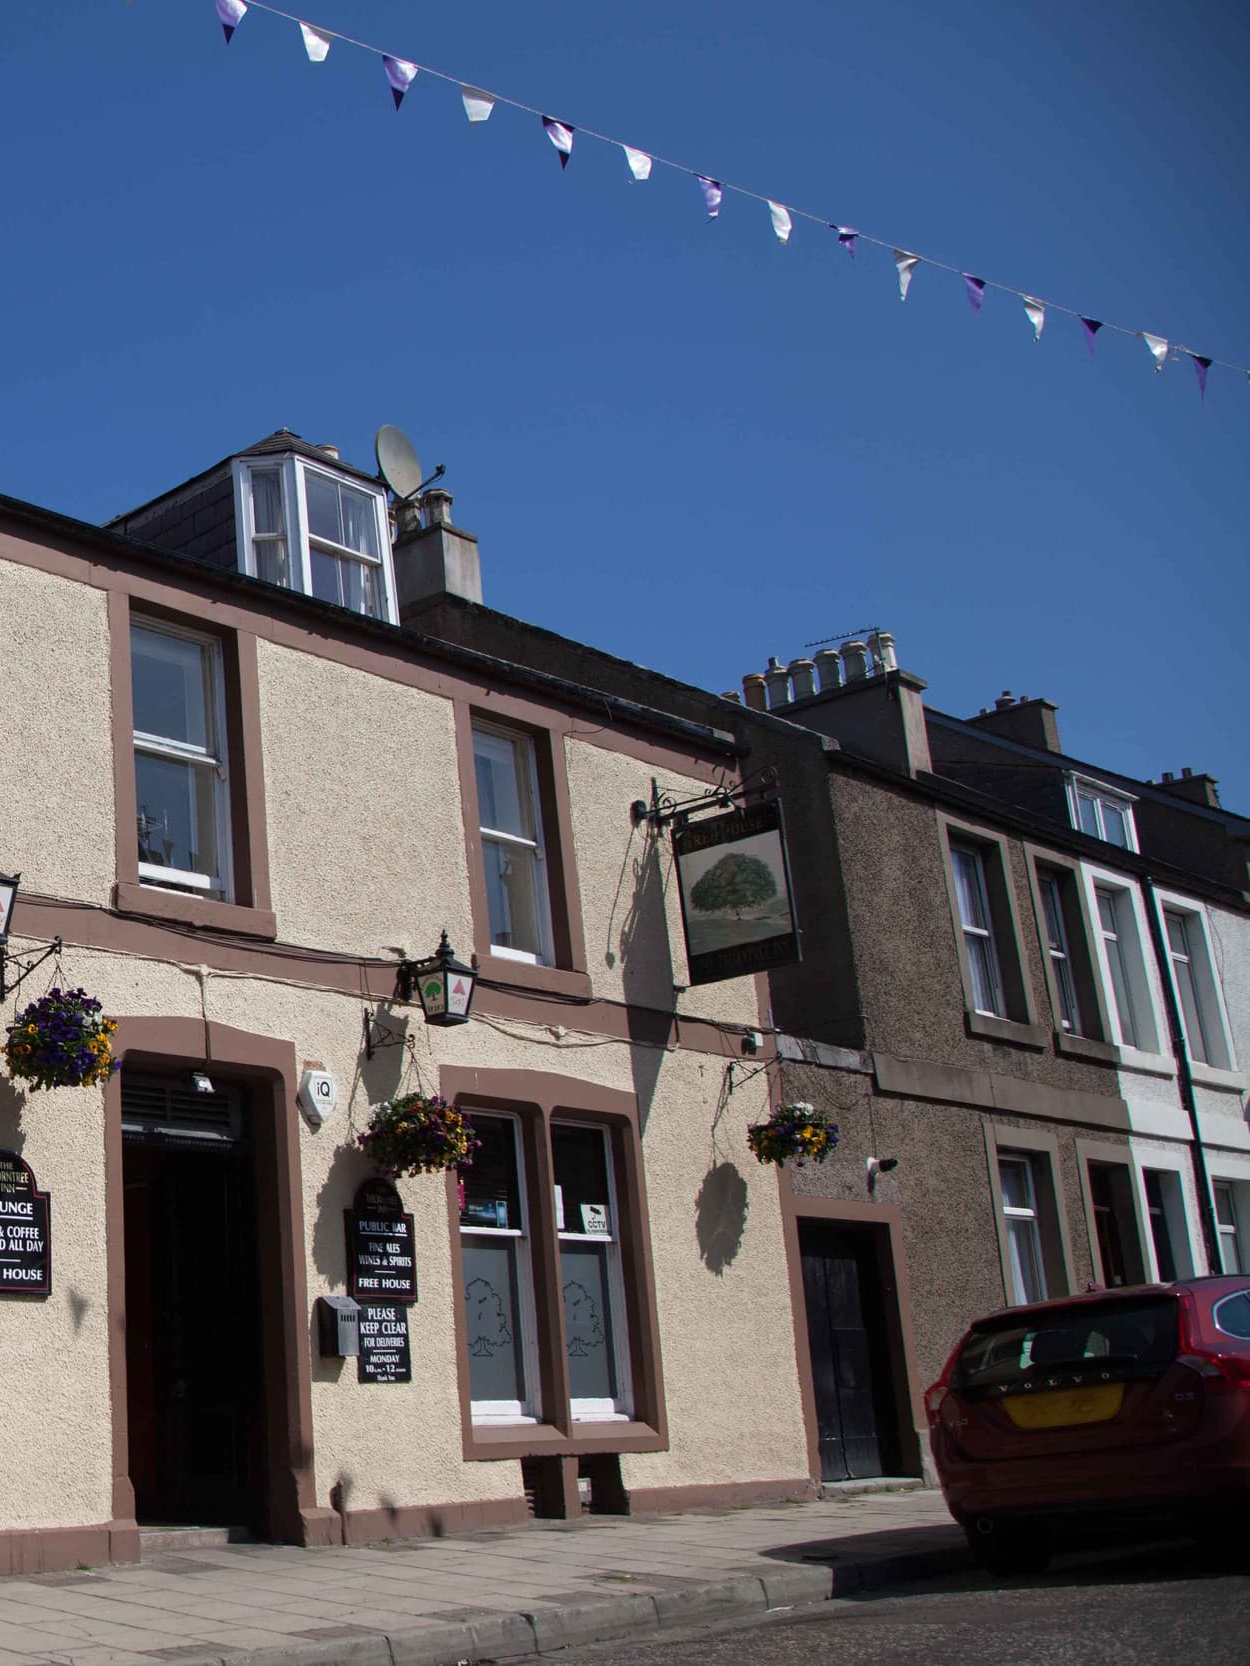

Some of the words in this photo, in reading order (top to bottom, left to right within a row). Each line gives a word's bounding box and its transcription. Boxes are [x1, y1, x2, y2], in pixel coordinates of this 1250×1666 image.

[317, 1081, 330, 1098] iQ
[0, 1183, 15, 1193] INN
[359, 1221, 390, 1232] PUBLIC
[588, 1220, 606, 1229] CCTV
[7, 1226, 40, 1239] COFFEE
[8, 1239, 24, 1251] ALL
[26, 1240, 44, 1252] DAY
[358, 1254, 381, 1265] WINES
[389, 1256, 412, 1267] SPIRITS
[2, 1268, 43, 1281] HOUSE
[358, 1278, 380, 1288] FREE
[382, 1279, 411, 1289] HOUSE
[367, 1308, 396, 1320] PLEASE
[360, 1322, 380, 1334] KEEP
[381, 1322, 407, 1334] CLEAR
[364, 1337, 375, 1348] FOR
[376, 1337, 405, 1347] DELIVERIES
[370, 1355, 400, 1363] MONDAY
[386, 1364, 396, 1373] 12
[998, 1372, 1110, 1392] VOLVO
